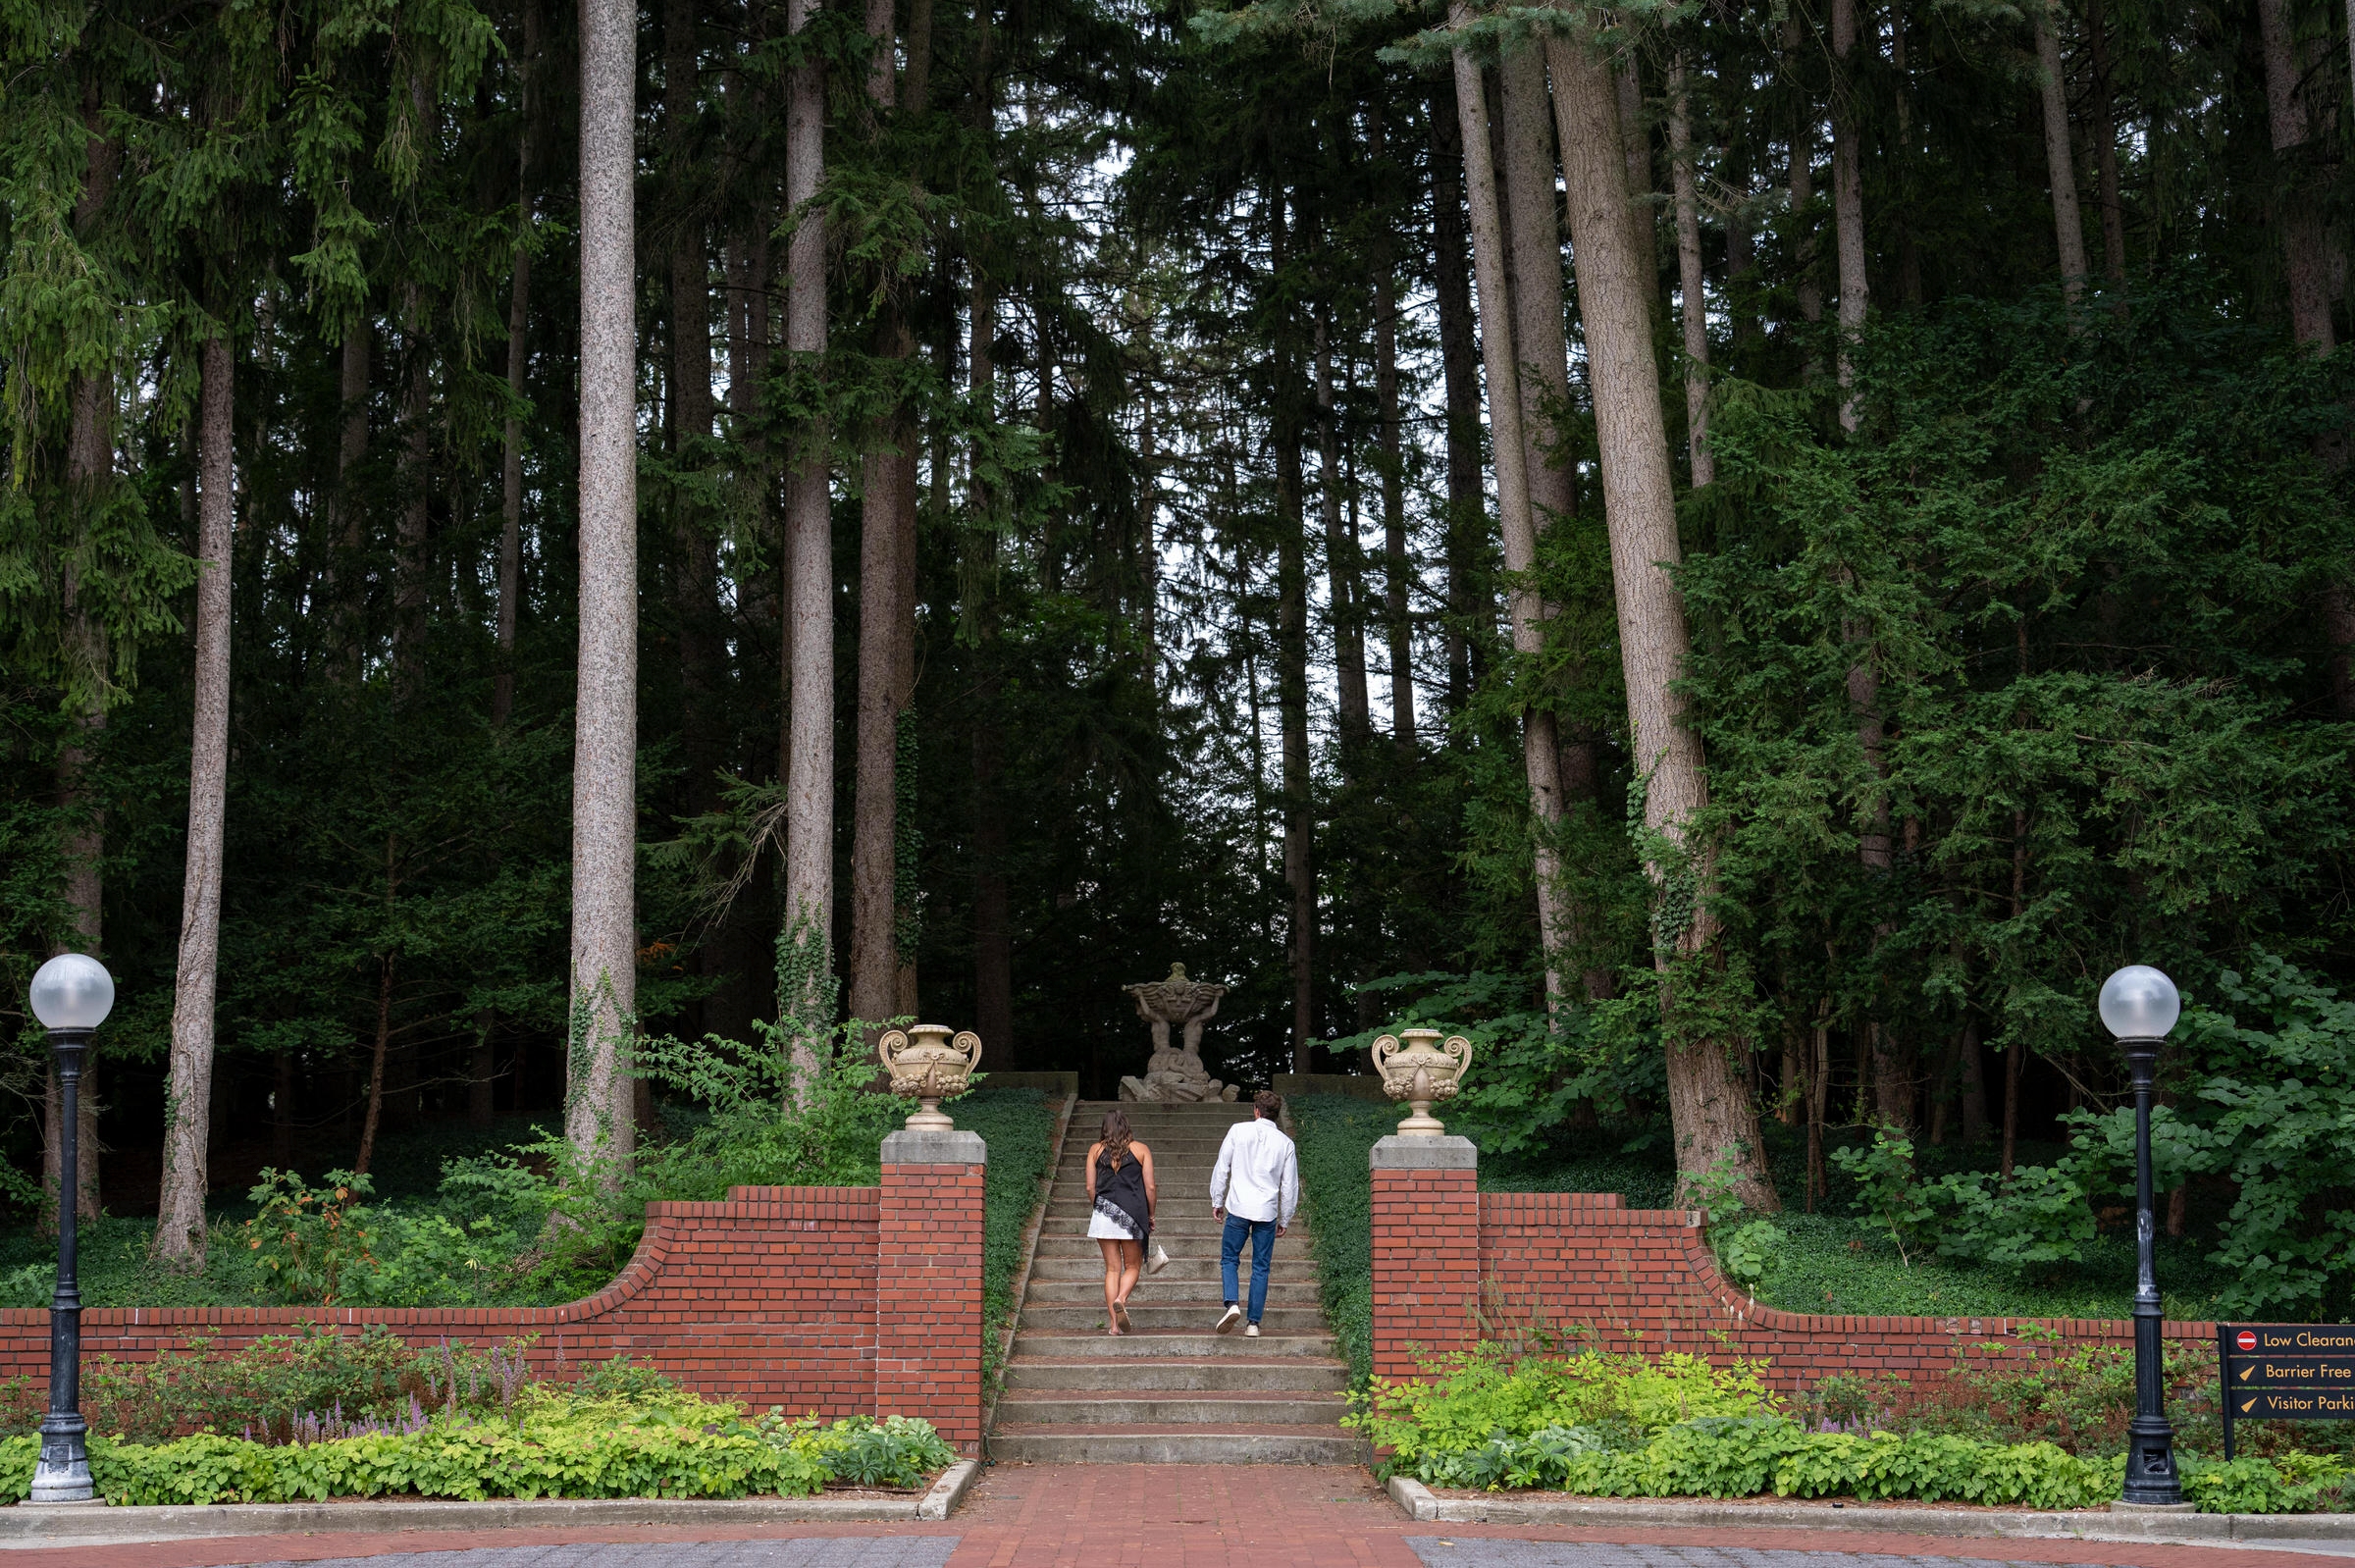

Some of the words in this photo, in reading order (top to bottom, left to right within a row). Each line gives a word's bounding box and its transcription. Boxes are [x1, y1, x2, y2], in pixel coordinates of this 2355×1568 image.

[2265, 1333, 2291, 1347] Low
[2296, 1332, 2355, 1347] Clearan
[2266, 1364, 2316, 1379] Barrier
[2320, 1364, 2352, 1379] Free
[2267, 1395, 2314, 1410] Visitor
